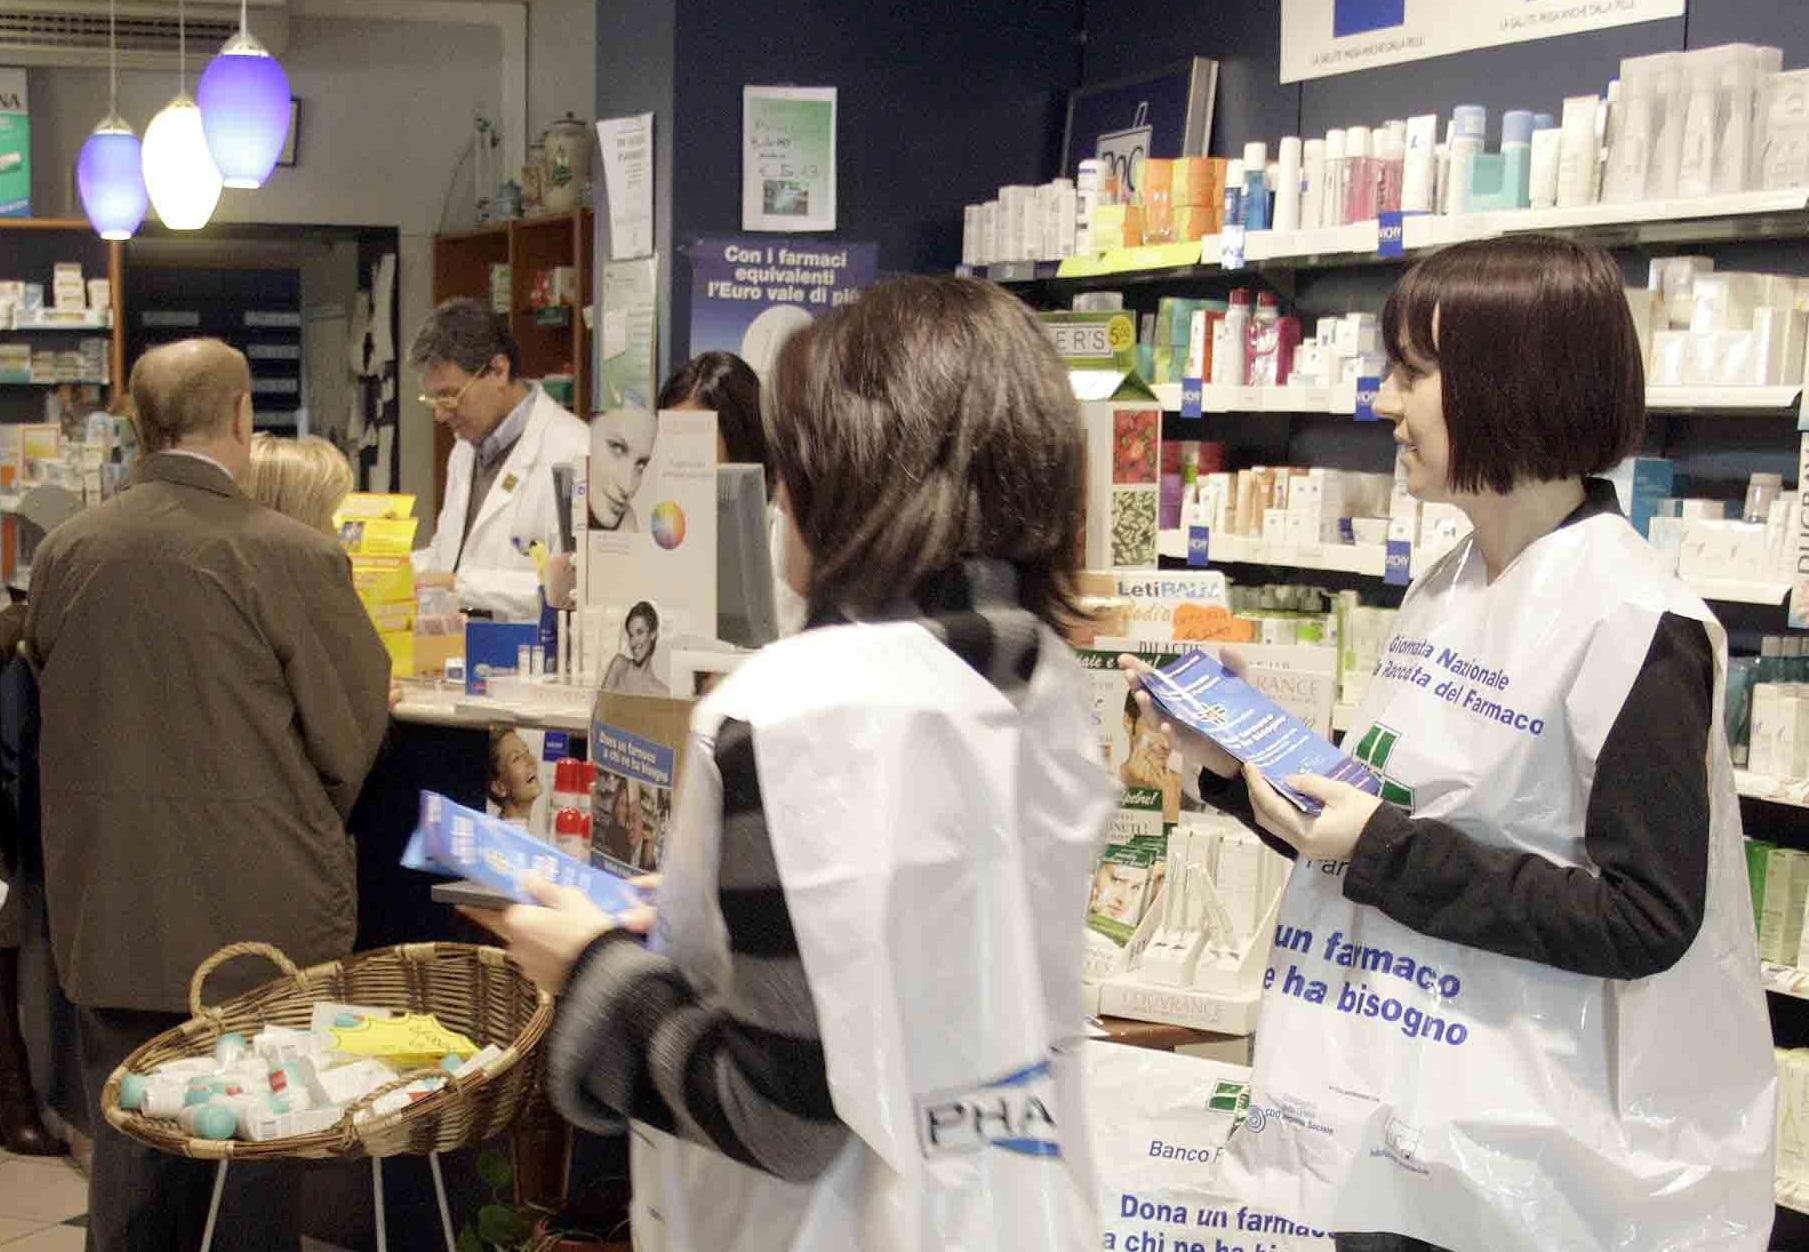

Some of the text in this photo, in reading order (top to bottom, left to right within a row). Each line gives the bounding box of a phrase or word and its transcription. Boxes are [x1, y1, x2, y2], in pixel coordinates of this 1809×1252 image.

[724, 245, 762, 264] Con
[779, 248, 848, 268] farmaci
[734, 266, 836, 287] equivalenti
[707, 281, 762, 300] l'Euro
[767, 284, 805, 302] vale
[809, 287, 827, 304] di
[1056, 329, 1105, 350] ER'S
[1436, 647, 1510, 691] Nazionale
[1434, 681, 1464, 704] del
[1462, 689, 1546, 736] Farmaco
[1274, 924, 1462, 999] un farmaco
[1282, 965, 1328, 1005] ha
[1336, 982, 1468, 1046] bisogno
[1148, 1140, 1210, 1163] Banco
[1120, 1193, 1187, 1224] Dona
[1197, 1208, 1228, 1229] un
[1104, 1232, 1117, 1250] a
[1125, 1230, 1165, 1252] chi
